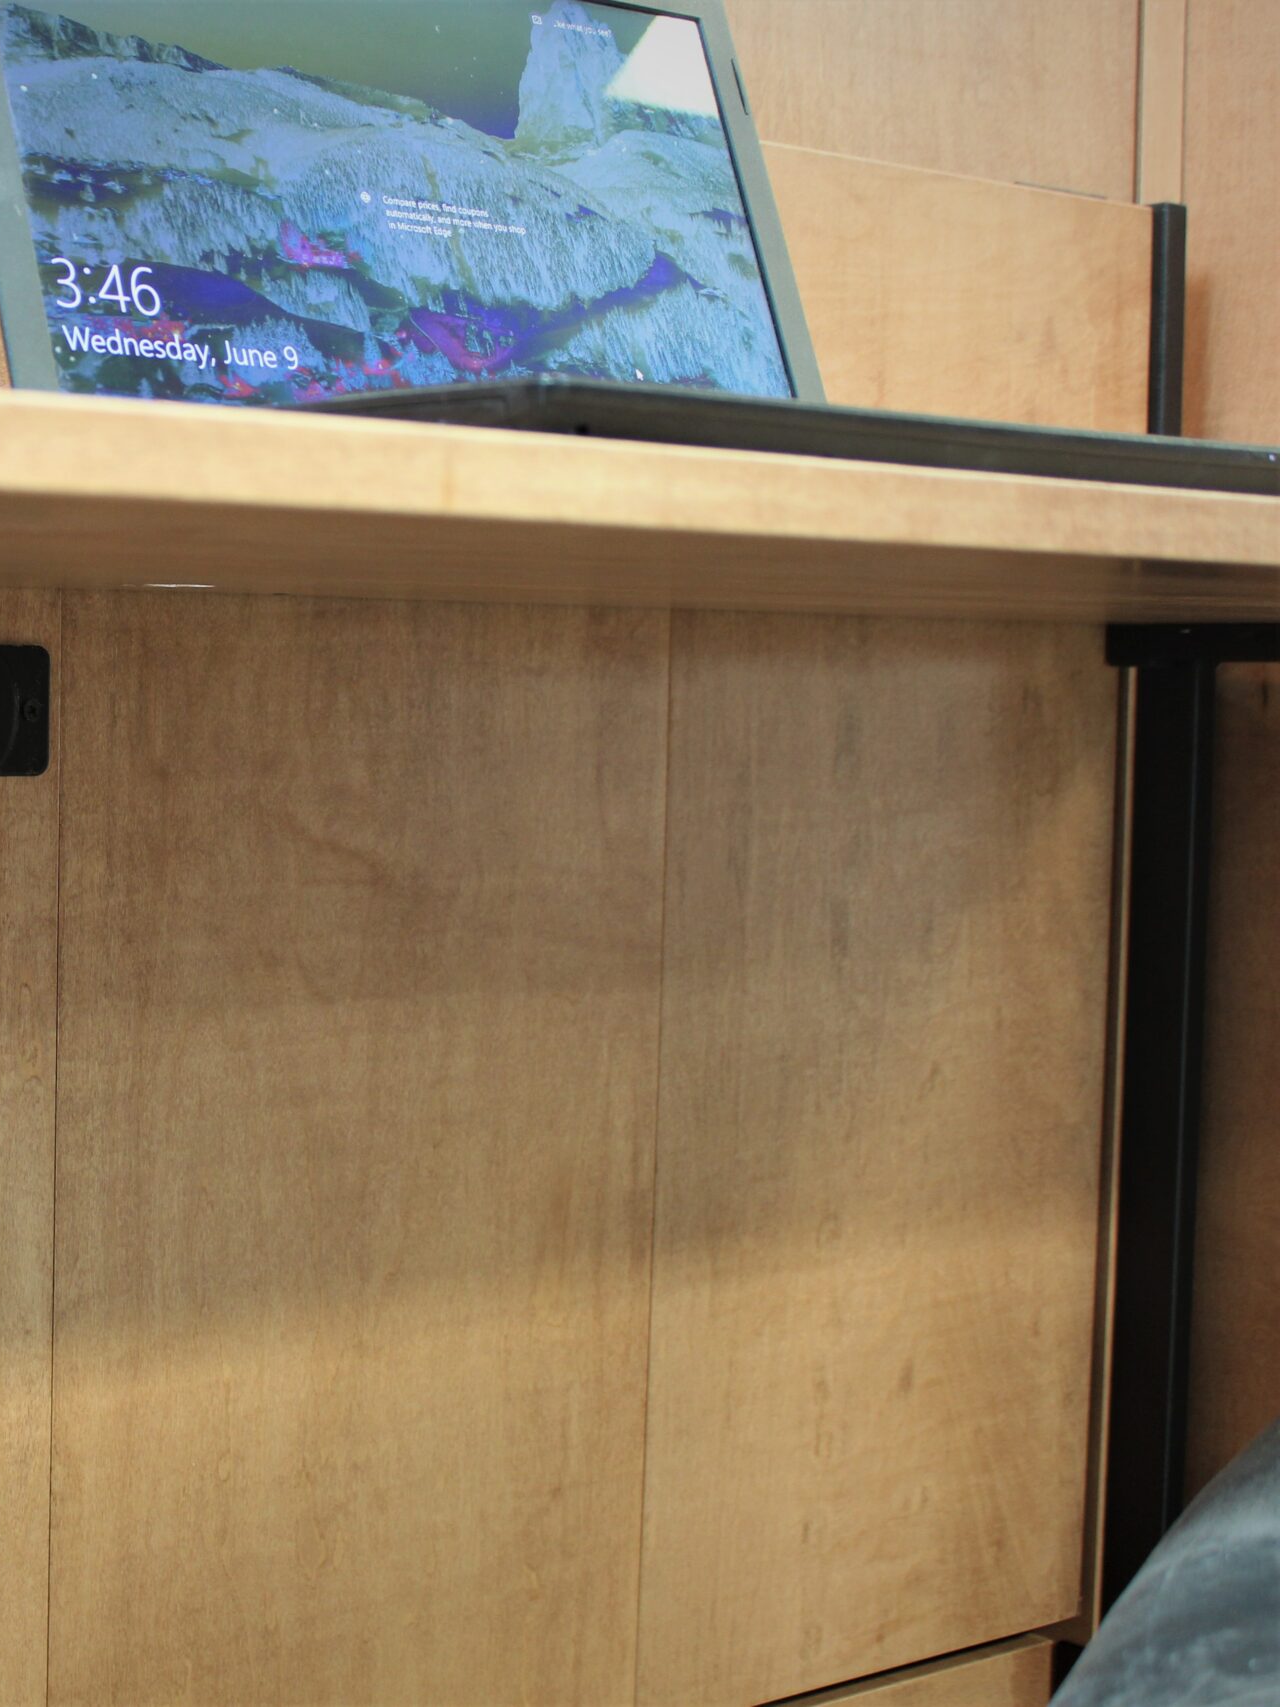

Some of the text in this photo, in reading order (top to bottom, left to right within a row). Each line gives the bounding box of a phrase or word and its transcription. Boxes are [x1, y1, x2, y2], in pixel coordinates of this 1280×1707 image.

[382, 195, 489, 218] Compare prices, find coupons
[385, 208, 527, 236] automatically, and more when you shop
[388, 221, 452, 238] in Microsoft Edge
[51, 257, 162, 317] 3:46
[61, 324, 300, 370] Wednesday, June 9
